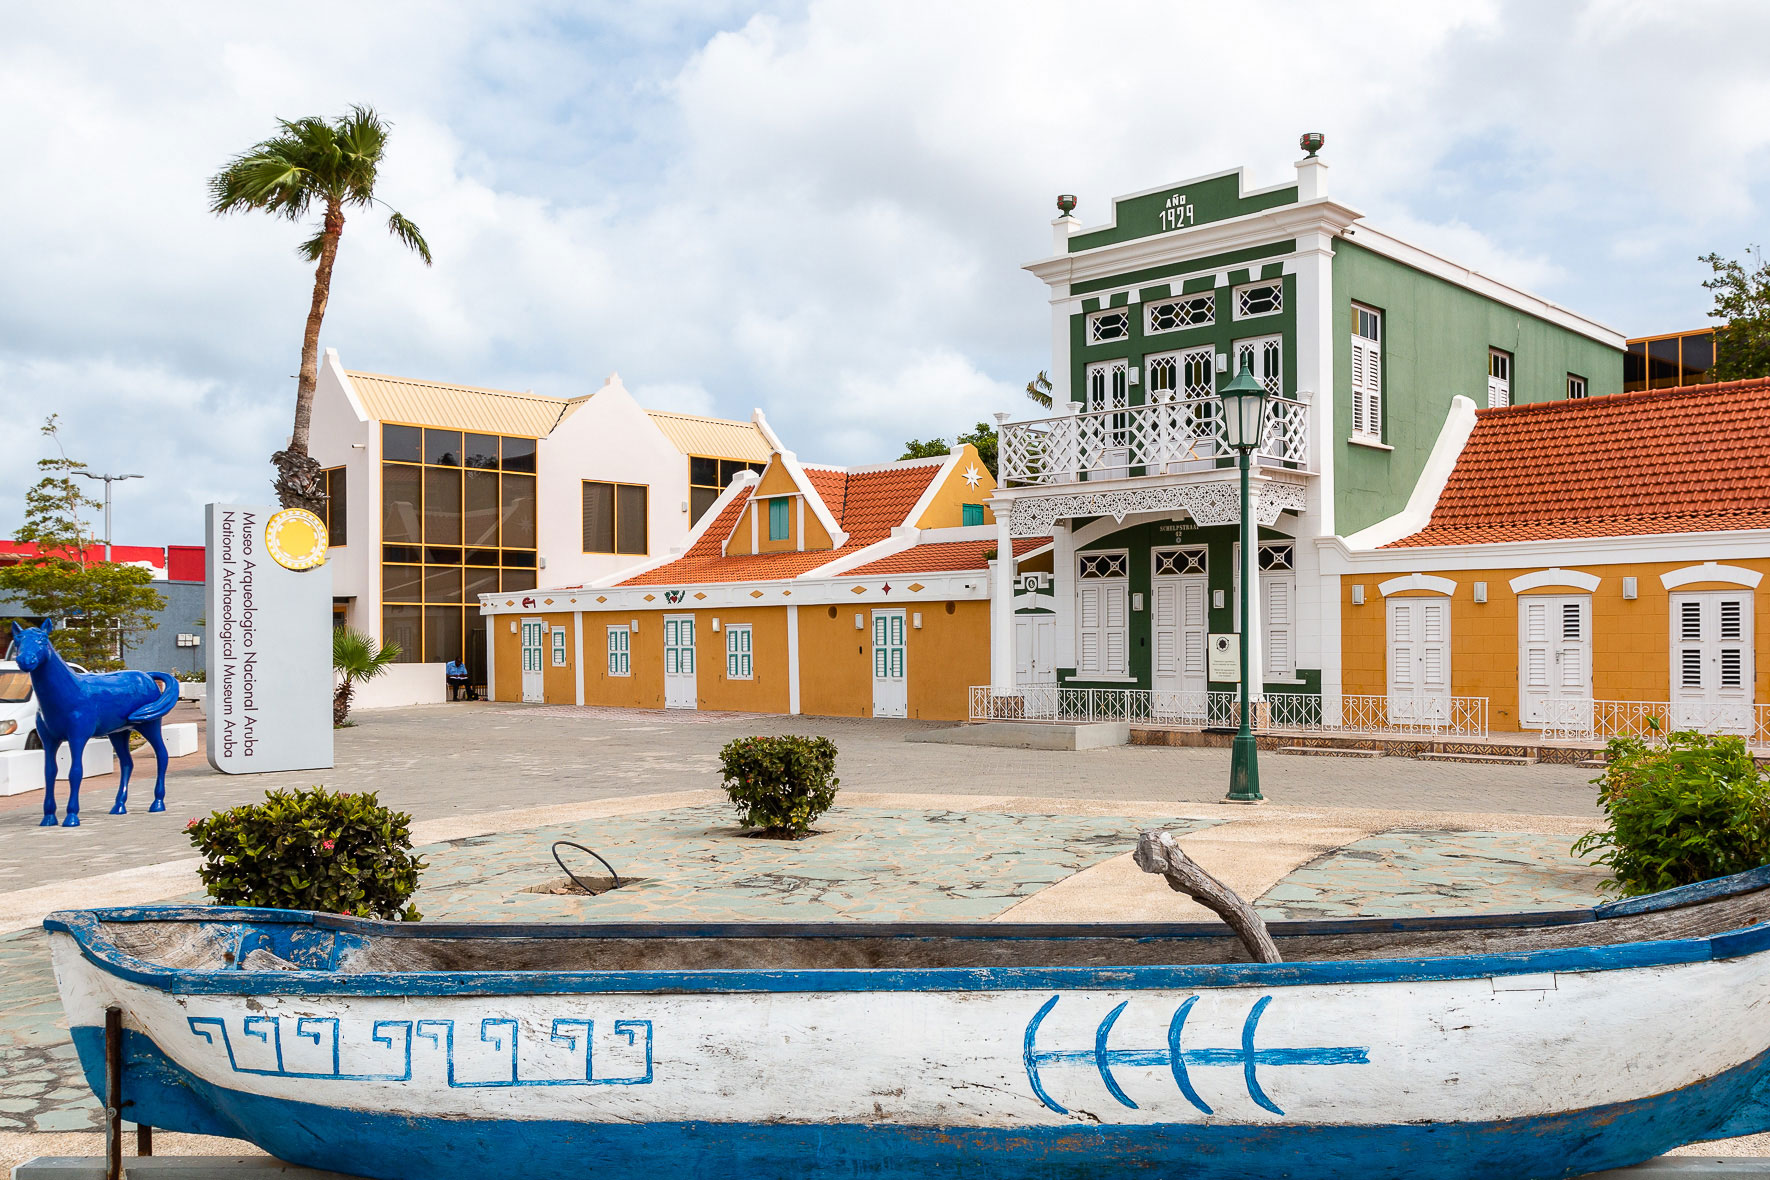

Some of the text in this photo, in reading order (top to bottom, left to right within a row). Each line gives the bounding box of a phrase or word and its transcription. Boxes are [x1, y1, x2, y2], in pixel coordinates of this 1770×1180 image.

[1159, 204, 1193, 230] 1929
[1166, 194, 1186, 208] AÑO
[219, 511, 238, 758] National Archaeological Museum Aruba
[239, 512, 259, 757] Museo Arqueologico Nacional Aruba
